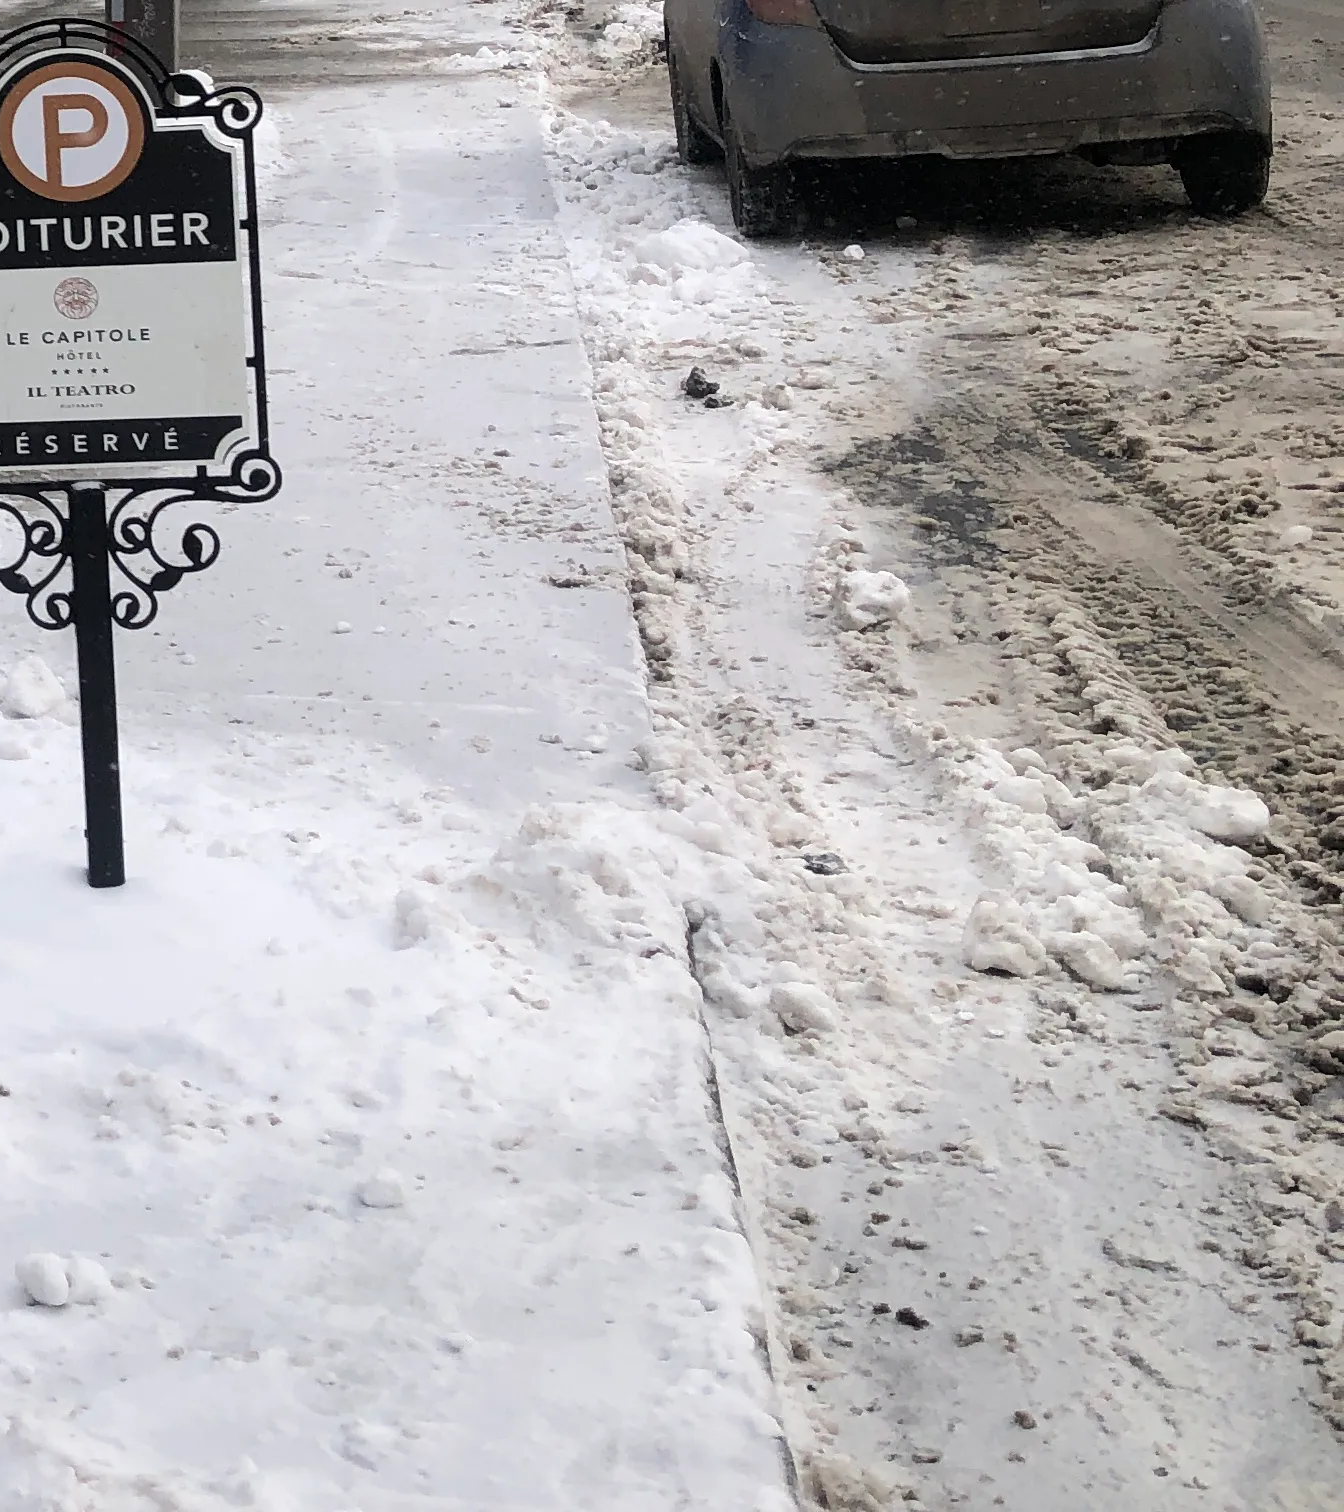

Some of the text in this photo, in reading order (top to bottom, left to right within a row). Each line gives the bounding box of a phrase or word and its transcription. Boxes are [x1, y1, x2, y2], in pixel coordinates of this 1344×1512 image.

[6, 328, 150, 346] LE CAPITOLE
[56, 349, 102, 361] HÔTEL
[27, 383, 136, 398] IL TEATRO
